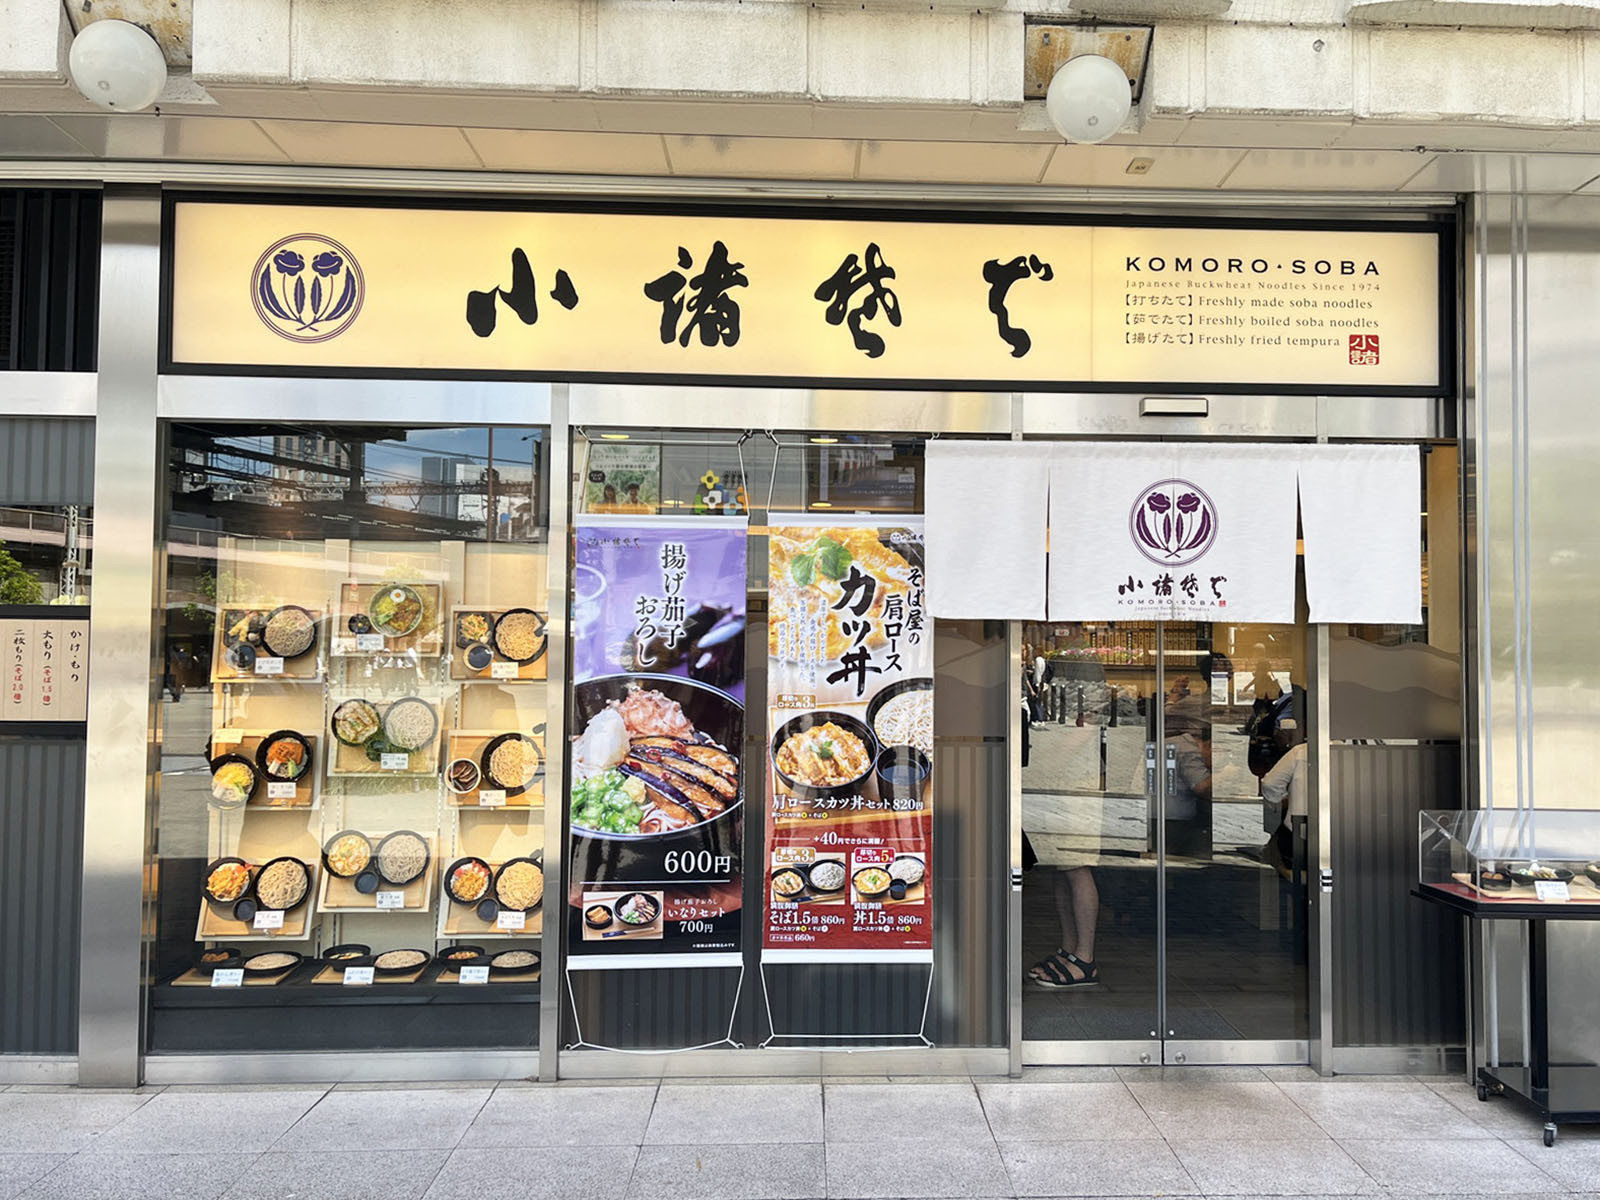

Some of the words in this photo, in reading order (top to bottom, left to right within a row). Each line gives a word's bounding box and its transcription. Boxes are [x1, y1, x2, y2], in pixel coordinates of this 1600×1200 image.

[1126, 279, 1181, 290] Japanese
[1187, 280, 1252, 290] Buckwheat
[1258, 282, 1306, 291] Noodles
[1312, 282, 1345, 291] Since
[1352, 283, 1380, 291] 1974
[1199, 296, 1245, 308] Freshly
[1251, 297, 1284, 308] made
[1289, 298, 1318, 309] soba
[1323, 298, 1372, 309] noodles
[1199, 315, 1245, 328] Freshly
[1251, 316, 1290, 327] boiled
[1296, 317, 1324, 327] soba
[1330, 318, 1379, 328] noodles
[1199, 334, 1245, 347] Freshly
[1251, 335, 1281, 346] fried
[1287, 336, 1340, 348] tempura
[661, 544, 687, 650] 揚げ茄子
[905, 567, 923, 646] そば屋の
[636, 596, 657, 666] おろし
[826, 566, 883, 698] カツ丼
[882, 594, 904, 672] 肩ロース
[70, 630, 82, 682] かけ・もり
[664, 850, 730, 874] 600円
[668, 907, 726, 918] いなりセット
[680, 920, 713, 933] 700円
